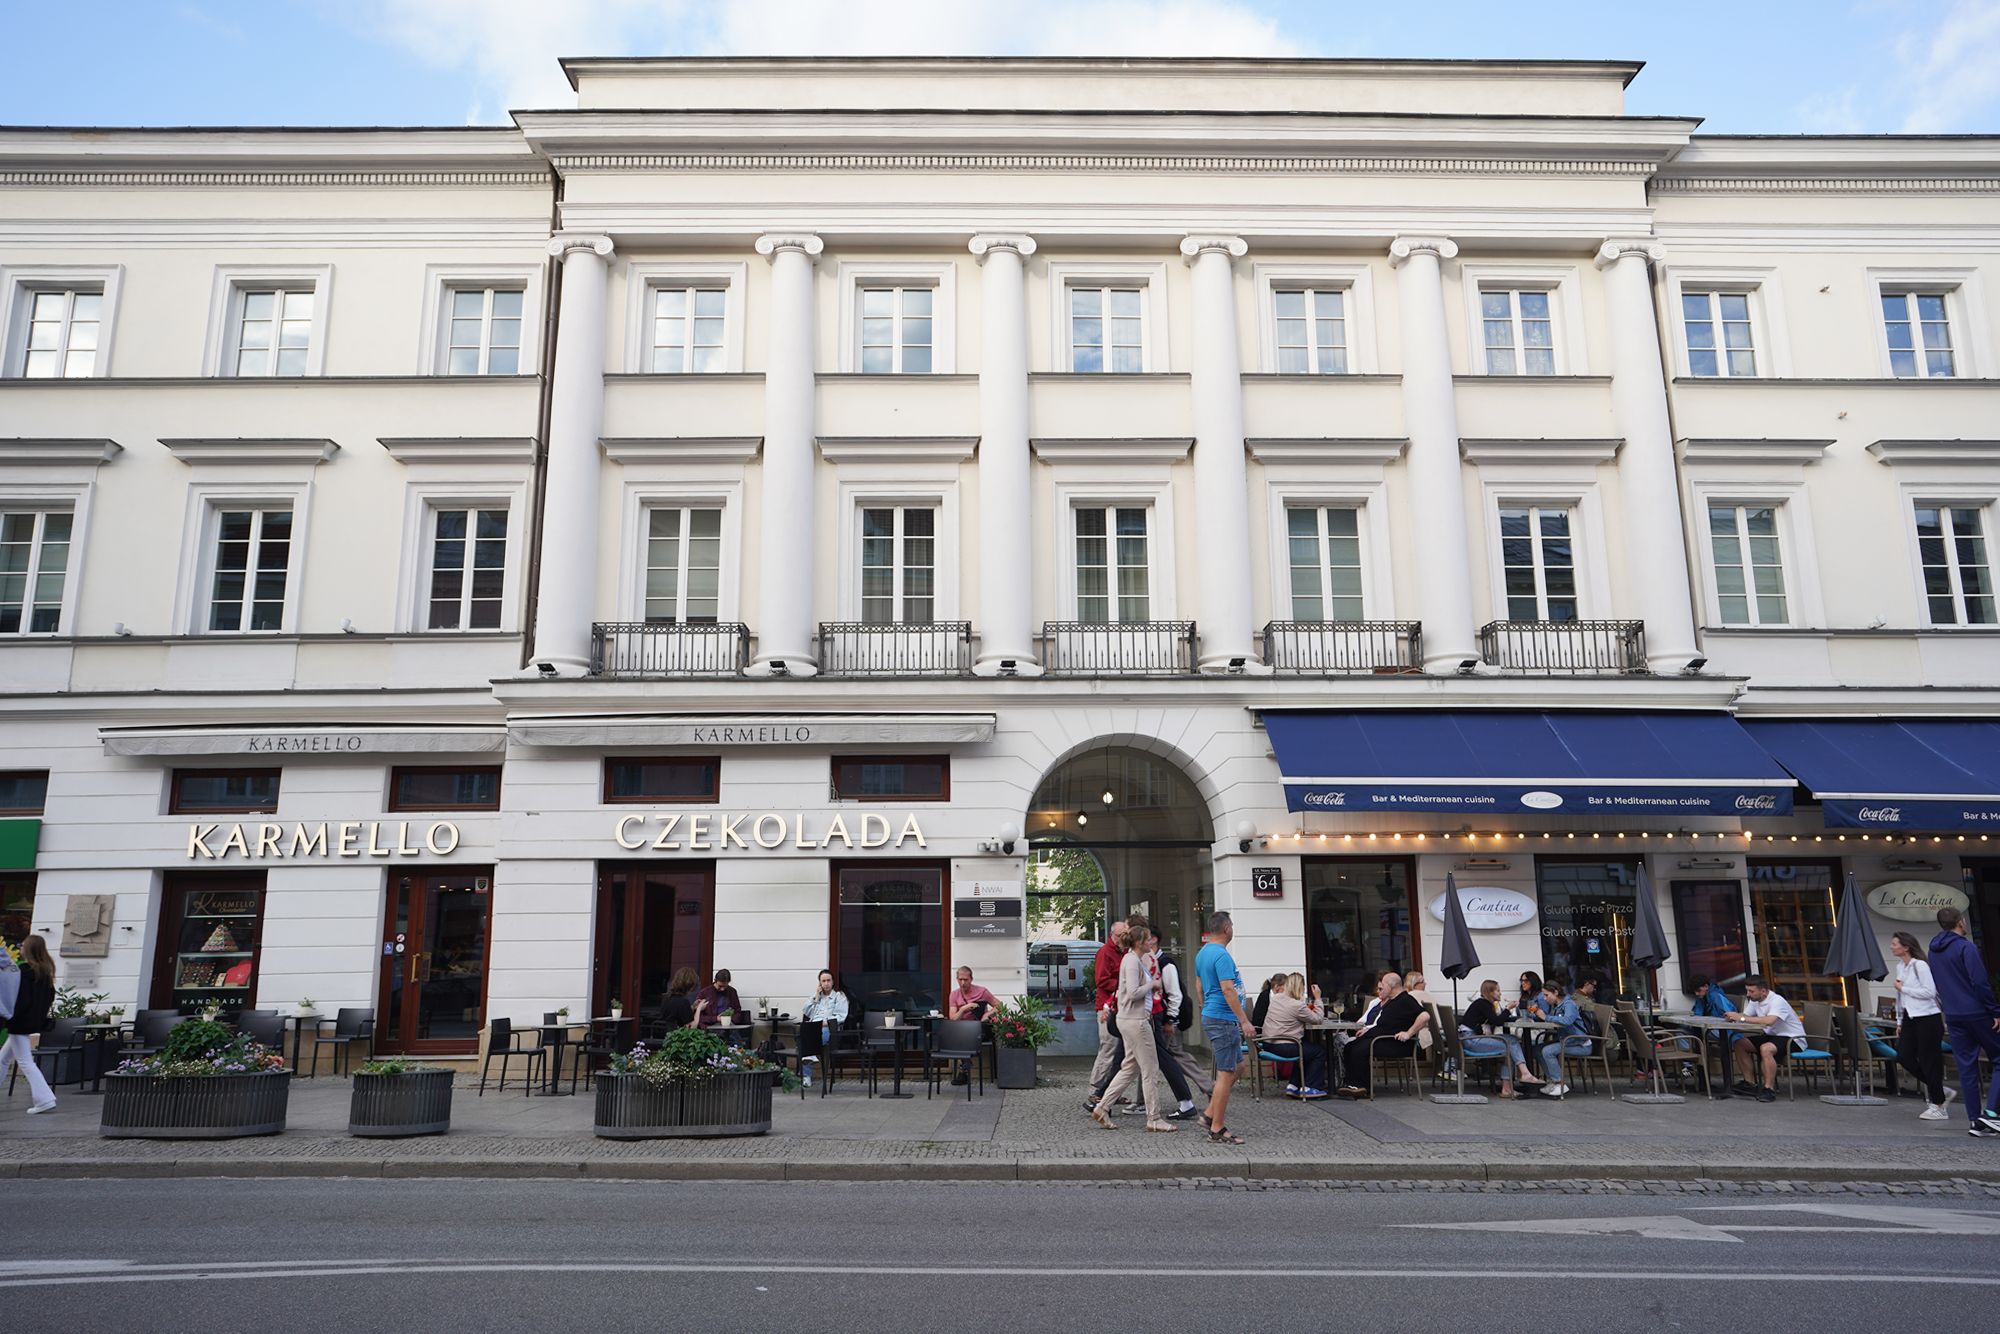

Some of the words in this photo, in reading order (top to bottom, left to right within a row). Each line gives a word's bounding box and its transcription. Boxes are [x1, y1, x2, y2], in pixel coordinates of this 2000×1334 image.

[694, 726, 811, 743] KARMELLO
[249, 736, 362, 751] KARMELLO
[1303, 791, 1346, 806] Coca-Cola
[1372, 795, 1388, 803] Bar
[1390, 795, 1397, 803] &
[1399, 795, 1463, 803] Mediterranean
[1464, 796, 1496, 804] cuisine
[1588, 796, 1604, 805] Bar
[1606, 797, 1613, 805] &
[1614, 797, 1678, 805] Mediterranean
[1679, 797, 1711, 806] cuisine
[1735, 795, 1777, 809] Coca-Cola
[1859, 807, 1901, 822] Coca-Cola
[1963, 811, 1979, 820] Bar
[1981, 812, 1989, 820] &
[614, 812, 927, 850] CZEKOLADA
[187, 820, 461, 859] KARMELLO
[1258, 874, 1279, 890] 64
[212, 900, 256, 908] KARMELLO
[1466, 897, 1521, 912] Cantina
[1878, 891, 1897, 905] La
[1902, 891, 1953, 905] Cantina
[1543, 905, 1578, 915] Gluten
[1580, 904, 1604, 914] Free
[1606, 904, 1633, 914] Pizza
[1542, 926, 1578, 937] Gluten
[1580, 926, 1607, 936] Free
